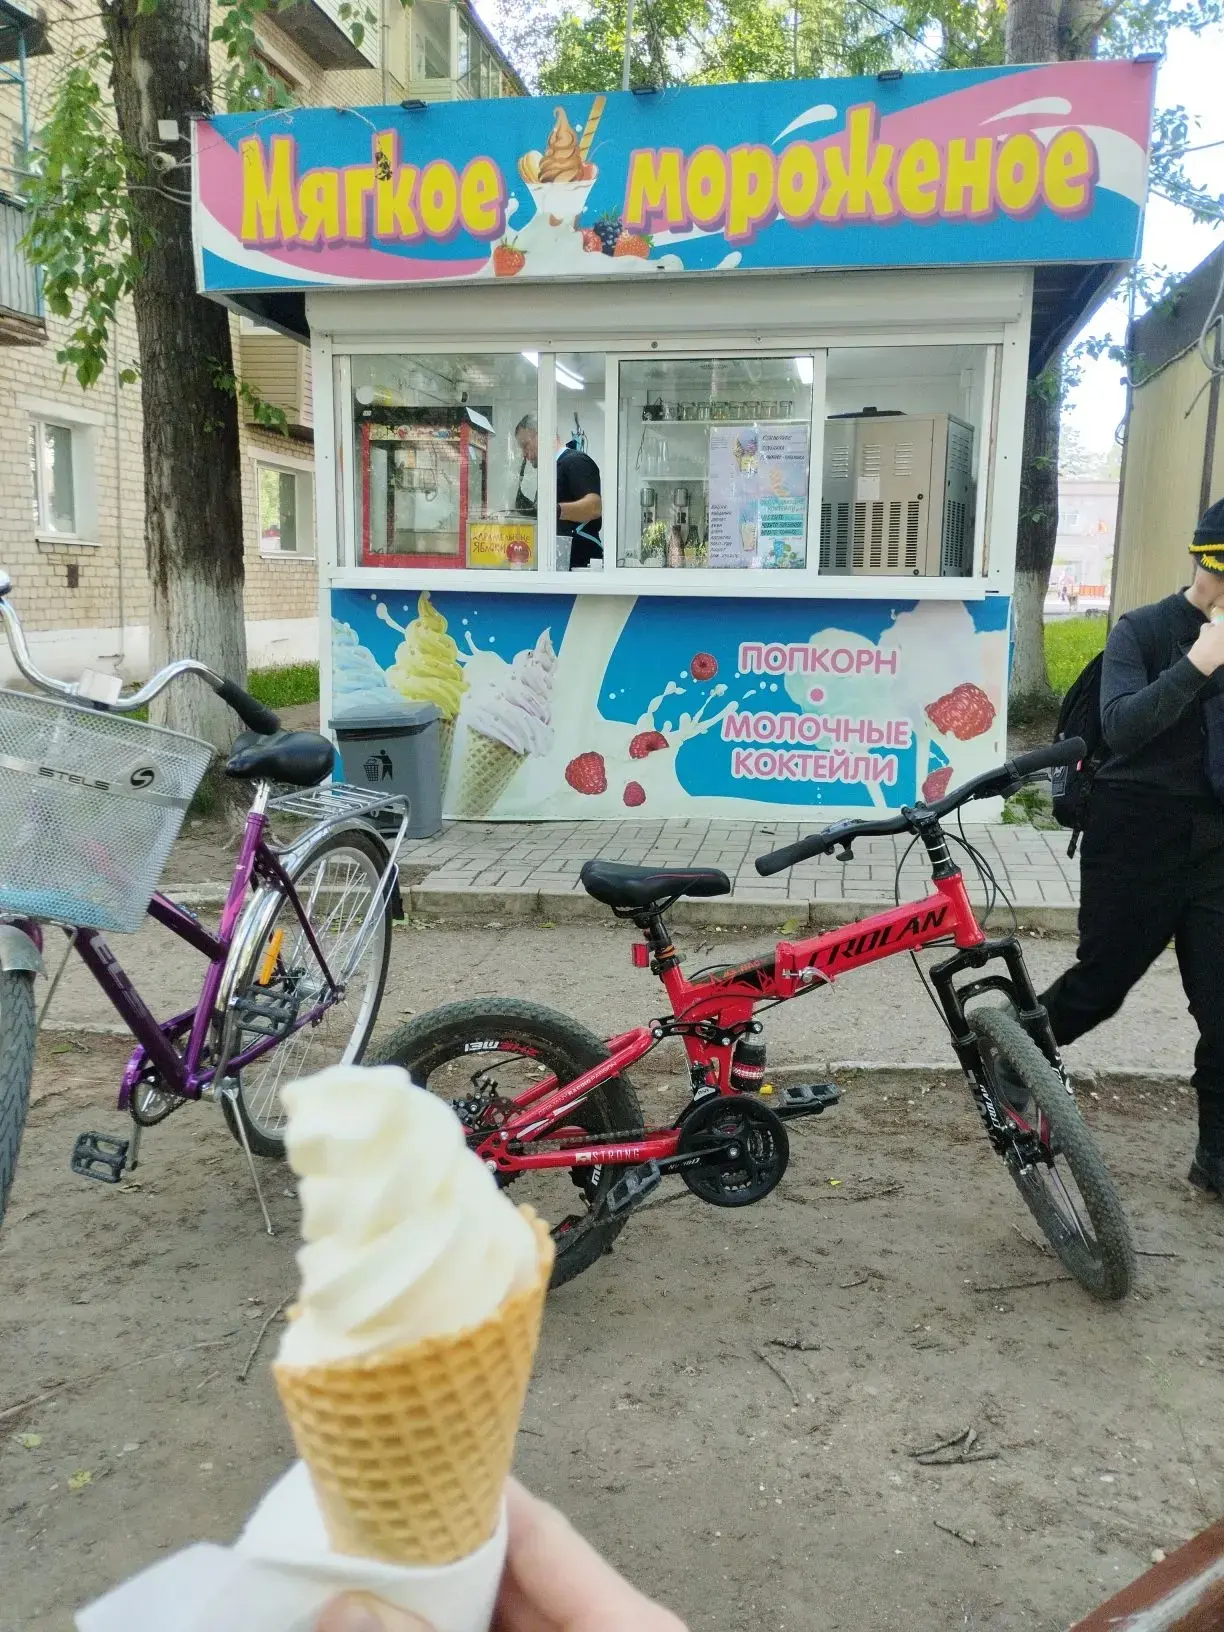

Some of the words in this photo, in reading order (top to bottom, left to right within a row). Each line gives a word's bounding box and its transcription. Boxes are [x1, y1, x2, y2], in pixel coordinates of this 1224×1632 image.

[239, 130, 502, 243] Мягкое
[625, 106, 1092, 238] мороженое
[740, 644, 898, 676] ПОПКОРН
[723, 714, 910, 748] МОЛОЧНЫЕ
[38, 767, 110, 791] STELS
[734, 749, 895, 784] КОКТЕЙЛИ
[805, 906, 948, 967] CROLAN
[567, 1079, 591, 1096] RACING
[591, 1149, 641, 1162] STRONG
